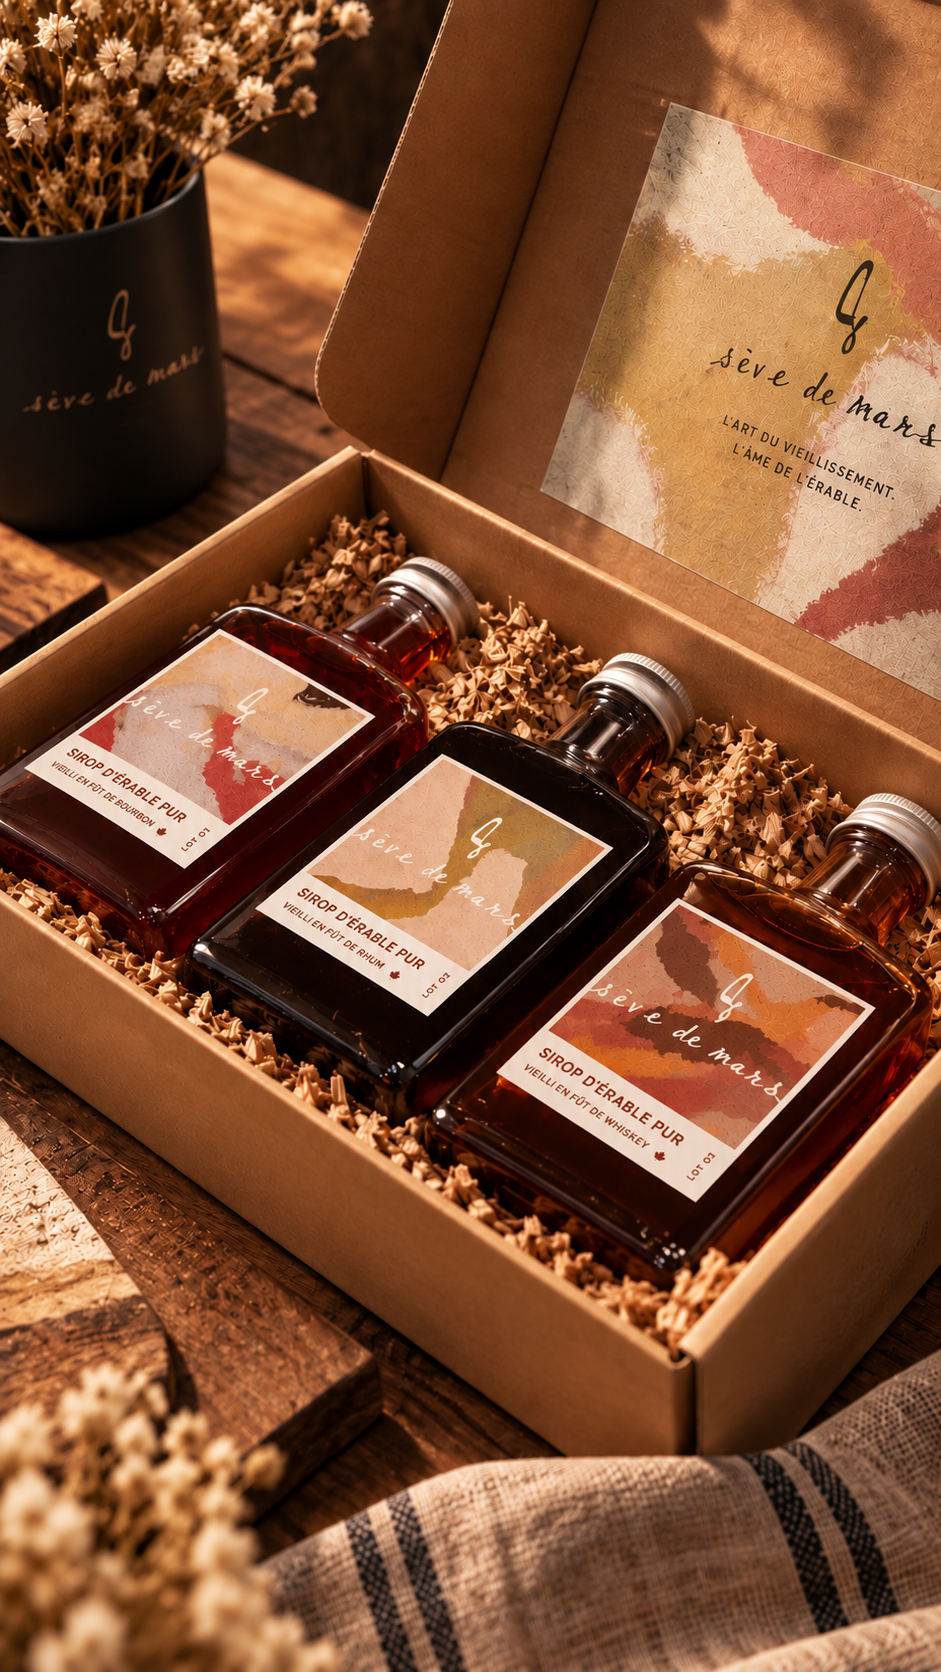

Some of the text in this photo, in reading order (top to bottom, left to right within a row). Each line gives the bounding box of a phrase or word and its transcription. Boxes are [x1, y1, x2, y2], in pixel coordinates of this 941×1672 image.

[106, 375, 136, 400] de
[146, 345, 205, 386] mars
[710, 347, 941, 448] sève de mars
[722, 414, 895, 500] L'ART DU VIEILLISSEMENT.
[775, 463, 793, 478] DE
[796, 472, 863, 512] L'ÉRABLE.
[66, 747, 188, 824] SIROP D'ÉRABLE PUR
[188, 729, 213, 748] de
[217, 746, 280, 792] mars
[75, 774, 89, 787] EN
[103, 792, 117, 804] DE
[114, 798, 157, 828] BOURBON
[181, 836, 198, 852] LOT
[297, 887, 426, 970] SIROP D'ÉRABLE PUR
[421, 864, 448, 884] de
[452, 882, 521, 932] mars
[283, 901, 314, 924] VIEILLI
[311, 918, 327, 931] EN
[343, 939, 358, 952] DE
[356, 948, 386, 970] RHUM
[421, 983, 439, 999] LOT
[590, 983, 784, 1103] sève de mars
[523, 1062, 651, 1150] VIEILLI EN FÛT DE WHISKEY
[538, 1047, 685, 1147] SIROP D'ÉRABLE PUR
[686, 1164, 704, 1182] LOT
